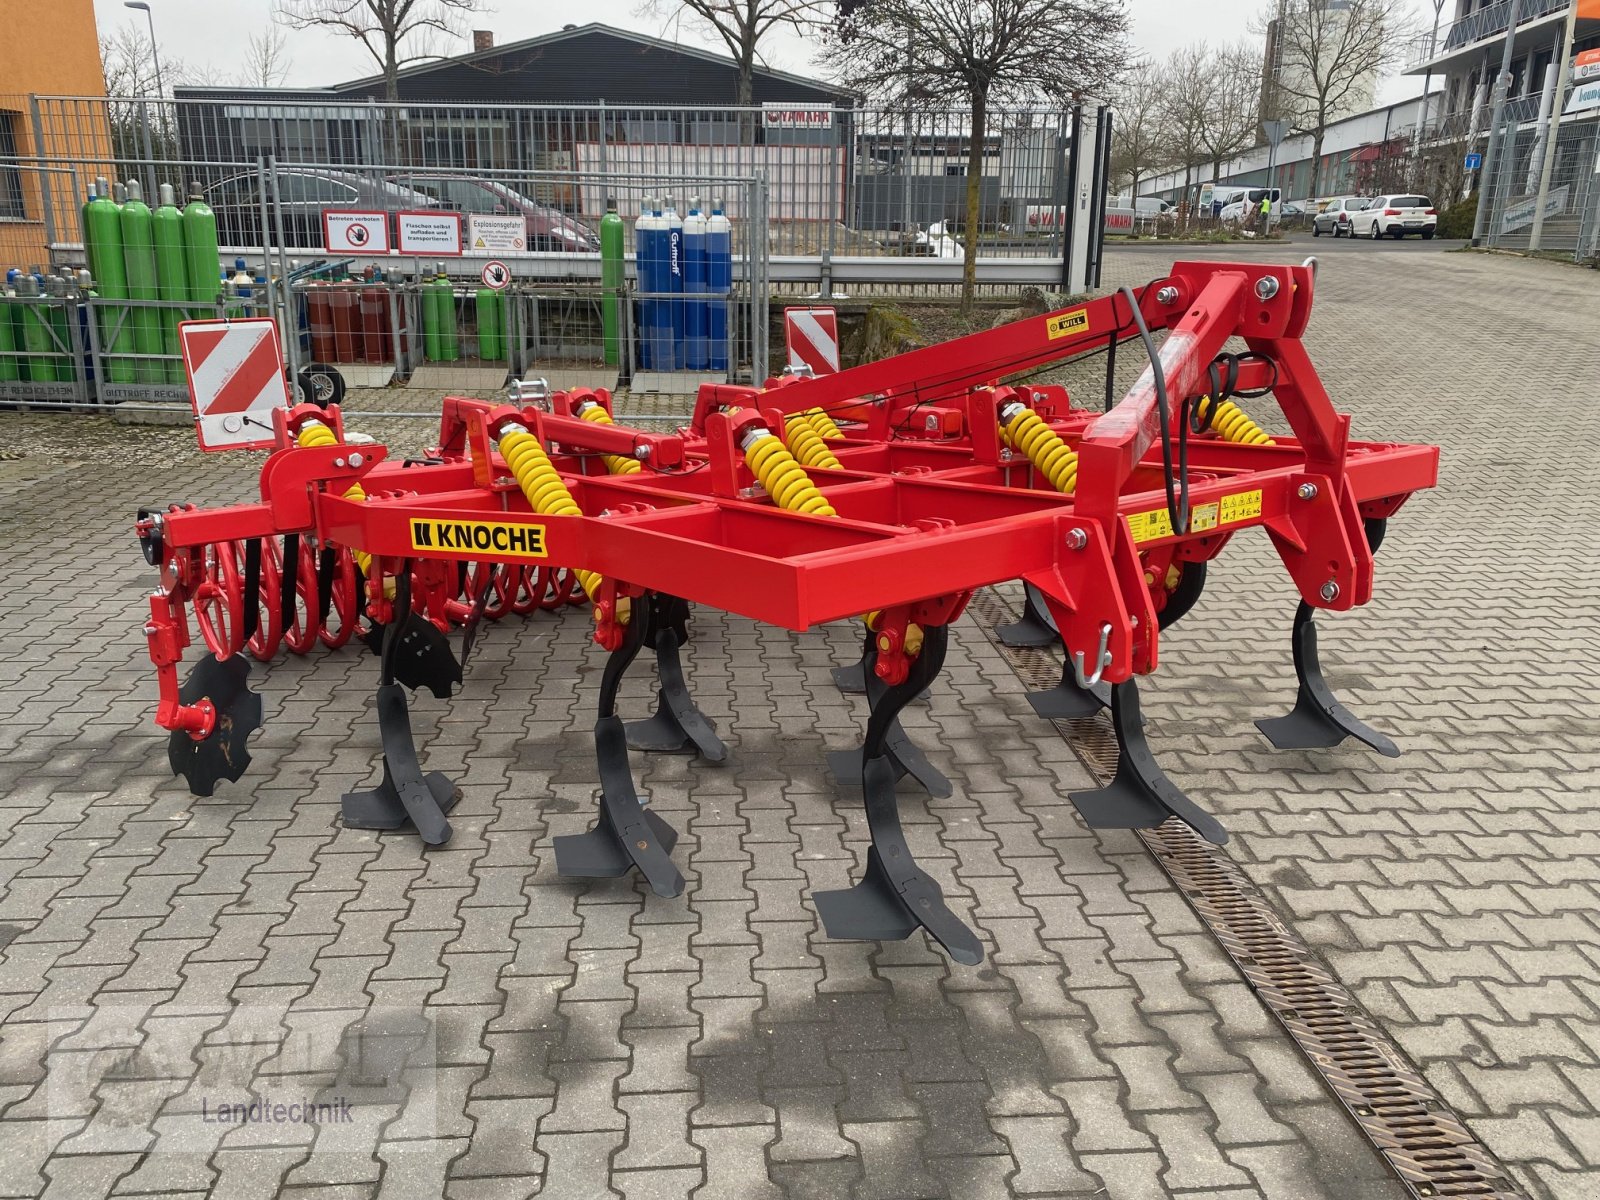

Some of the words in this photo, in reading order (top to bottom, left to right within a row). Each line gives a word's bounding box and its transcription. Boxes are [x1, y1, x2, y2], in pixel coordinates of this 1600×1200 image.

[781, 110, 829, 122] YAMAHA
[1106, 214, 1132, 229] YAMAHA
[671, 232, 681, 276] Guttroff
[1062, 317, 1082, 328] WILL
[436, 523, 543, 553] KNOCHE
